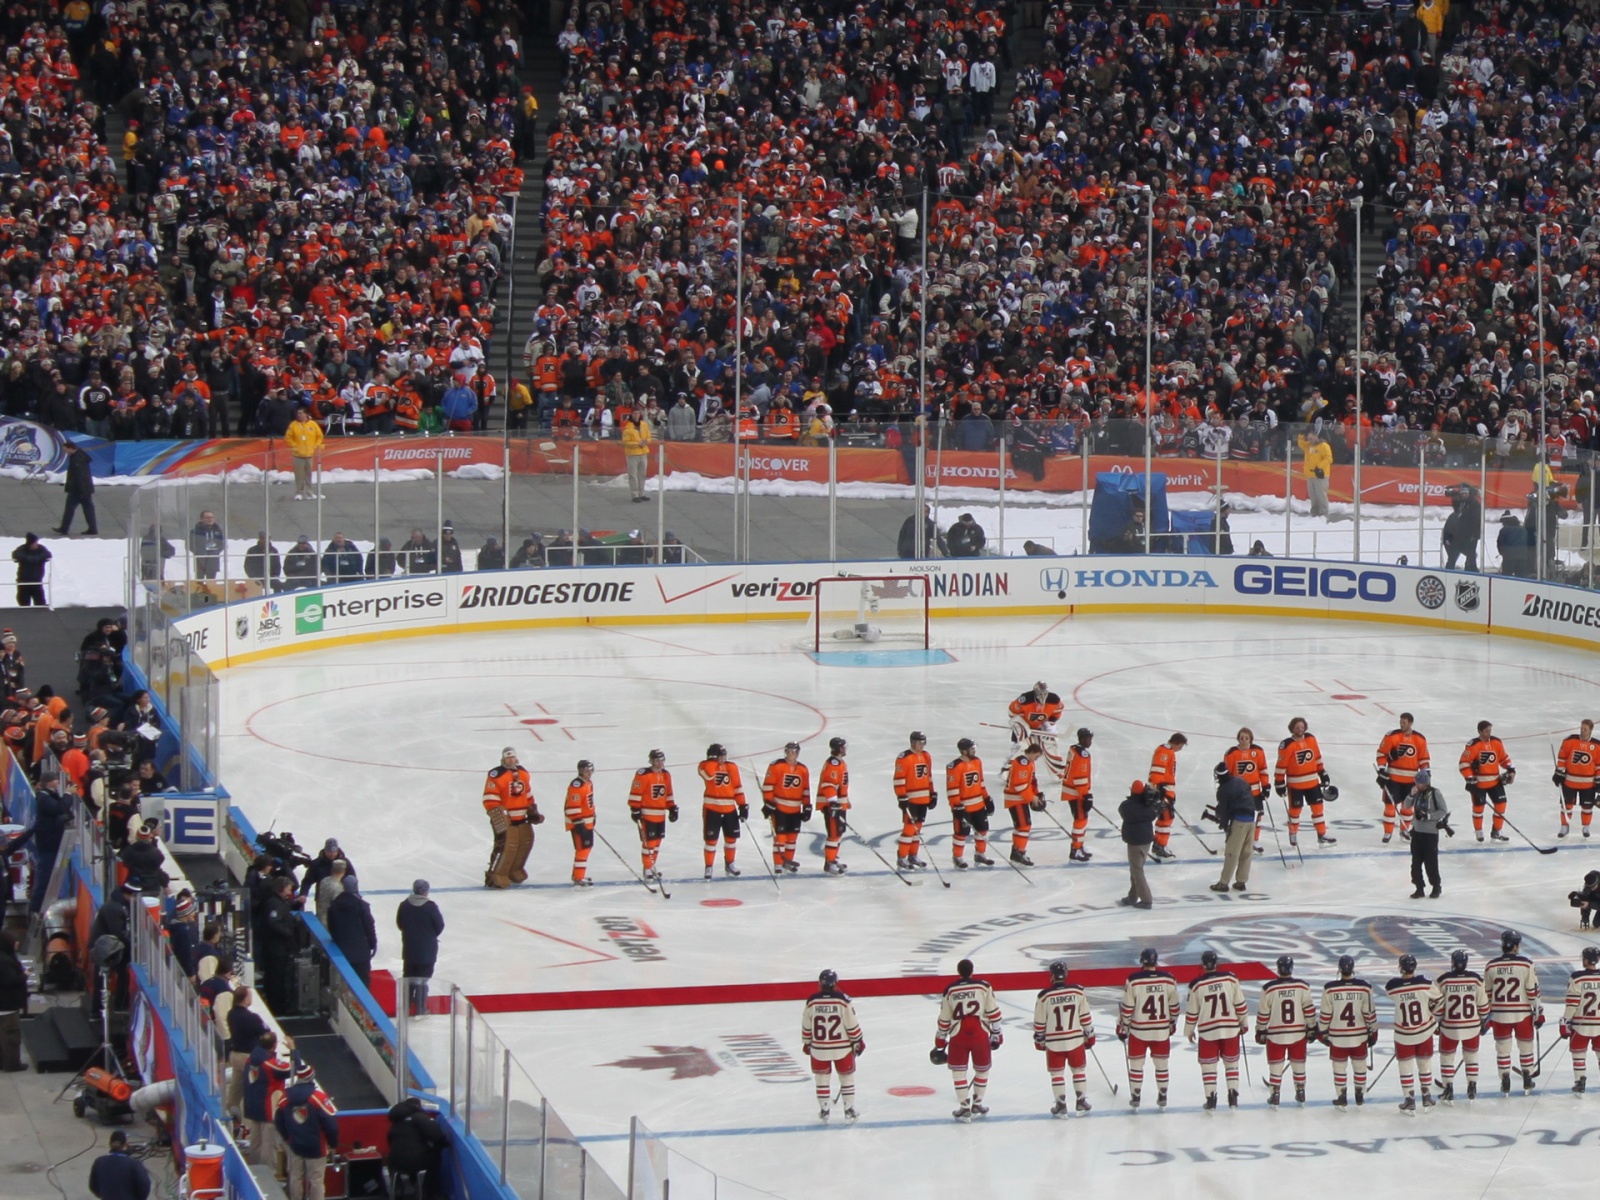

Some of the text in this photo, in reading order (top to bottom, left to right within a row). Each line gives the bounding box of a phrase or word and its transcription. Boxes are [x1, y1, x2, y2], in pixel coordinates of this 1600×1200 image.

[384, 448, 473, 460] BRIDGESTONE
[739, 456, 809, 472] DISCOVER
[942, 466, 1018, 479] HONDA
[1194, 474, 1202, 486] it
[1397, 482, 1446, 496] verizo
[909, 565, 942, 573] MOLSON
[1075, 570, 1219, 588] HONDA
[1234, 564, 1396, 603] GEICO
[459, 582, 635, 609] BRIDGESTONE
[1459, 589, 1478, 605] NHL
[297, 589, 444, 623] enterprise
[260, 617, 281, 630] NBC
[594, 916, 667, 962] verizon
[1497, 967, 1514, 975] BOYLE
[1146, 985, 1165, 993] BICKEL
[1208, 983, 1223, 993] RUPP
[1278, 989, 1296, 998] PRUST
[1334, 992, 1345, 1001] DEL
[1494, 977, 1521, 1002] 22
[815, 1005, 838, 1014] HAGELIN
[1050, 995, 1076, 1006] DUBINSKY
[1142, 995, 1166, 1020] 41
[1204, 992, 1230, 1018] 71
[1448, 995, 1475, 1019] 26
[1053, 1004, 1076, 1031] 17
[1281, 999, 1296, 1024] 8
[1340, 1002, 1356, 1027] 4
[1400, 1000, 1423, 1027] 18
[813, 1015, 842, 1041] 62
[718, 1033, 813, 1084] CANADIAN
[1106, 1132, 1518, 1167] CLASSIC
